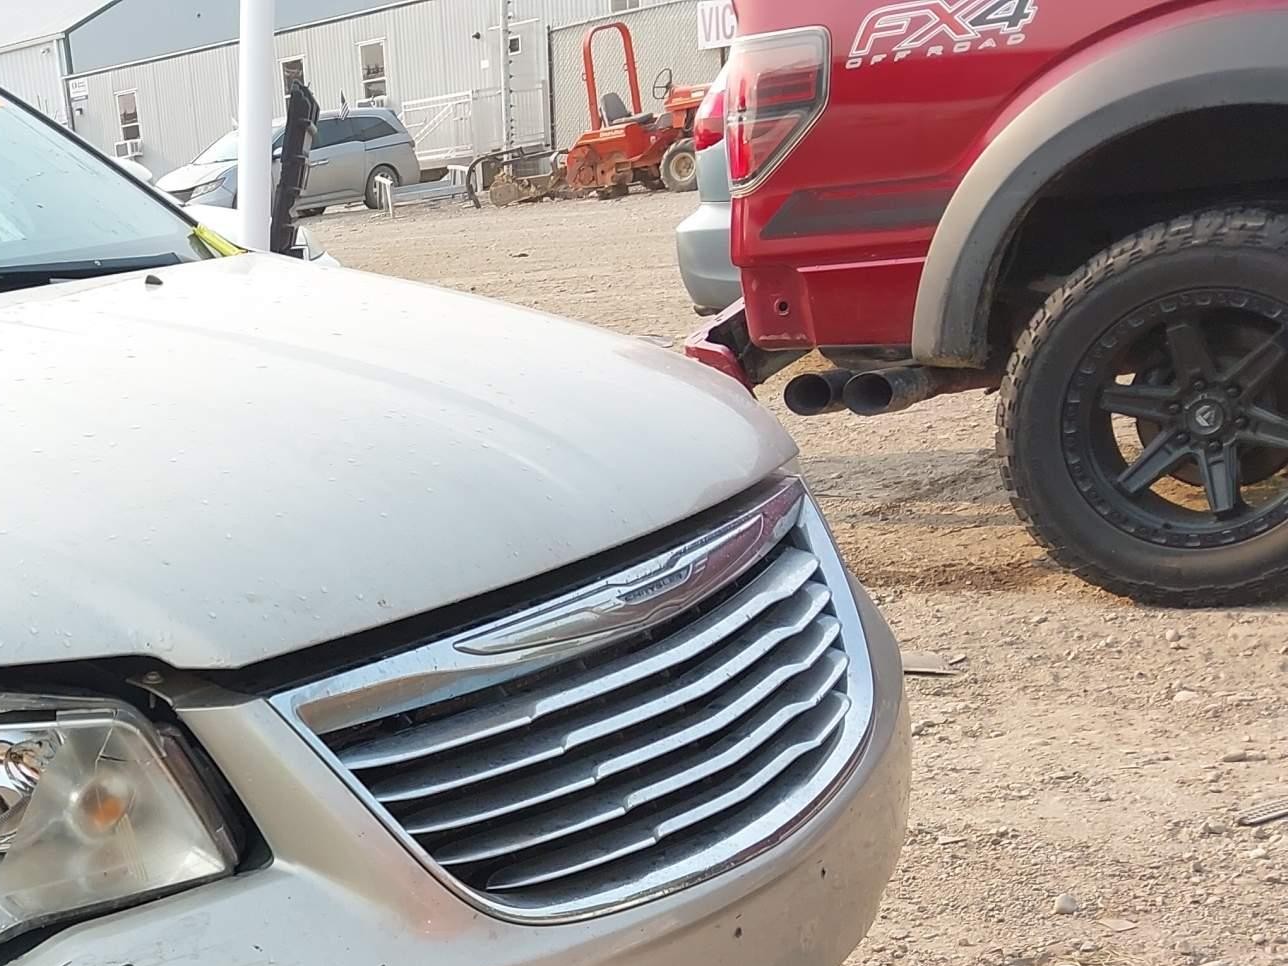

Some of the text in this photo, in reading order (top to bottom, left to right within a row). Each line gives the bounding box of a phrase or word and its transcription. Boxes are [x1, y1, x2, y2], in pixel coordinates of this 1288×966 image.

[846, 34, 1025, 69] OFF ROAD
[849, 0, 1037, 57] FX4
